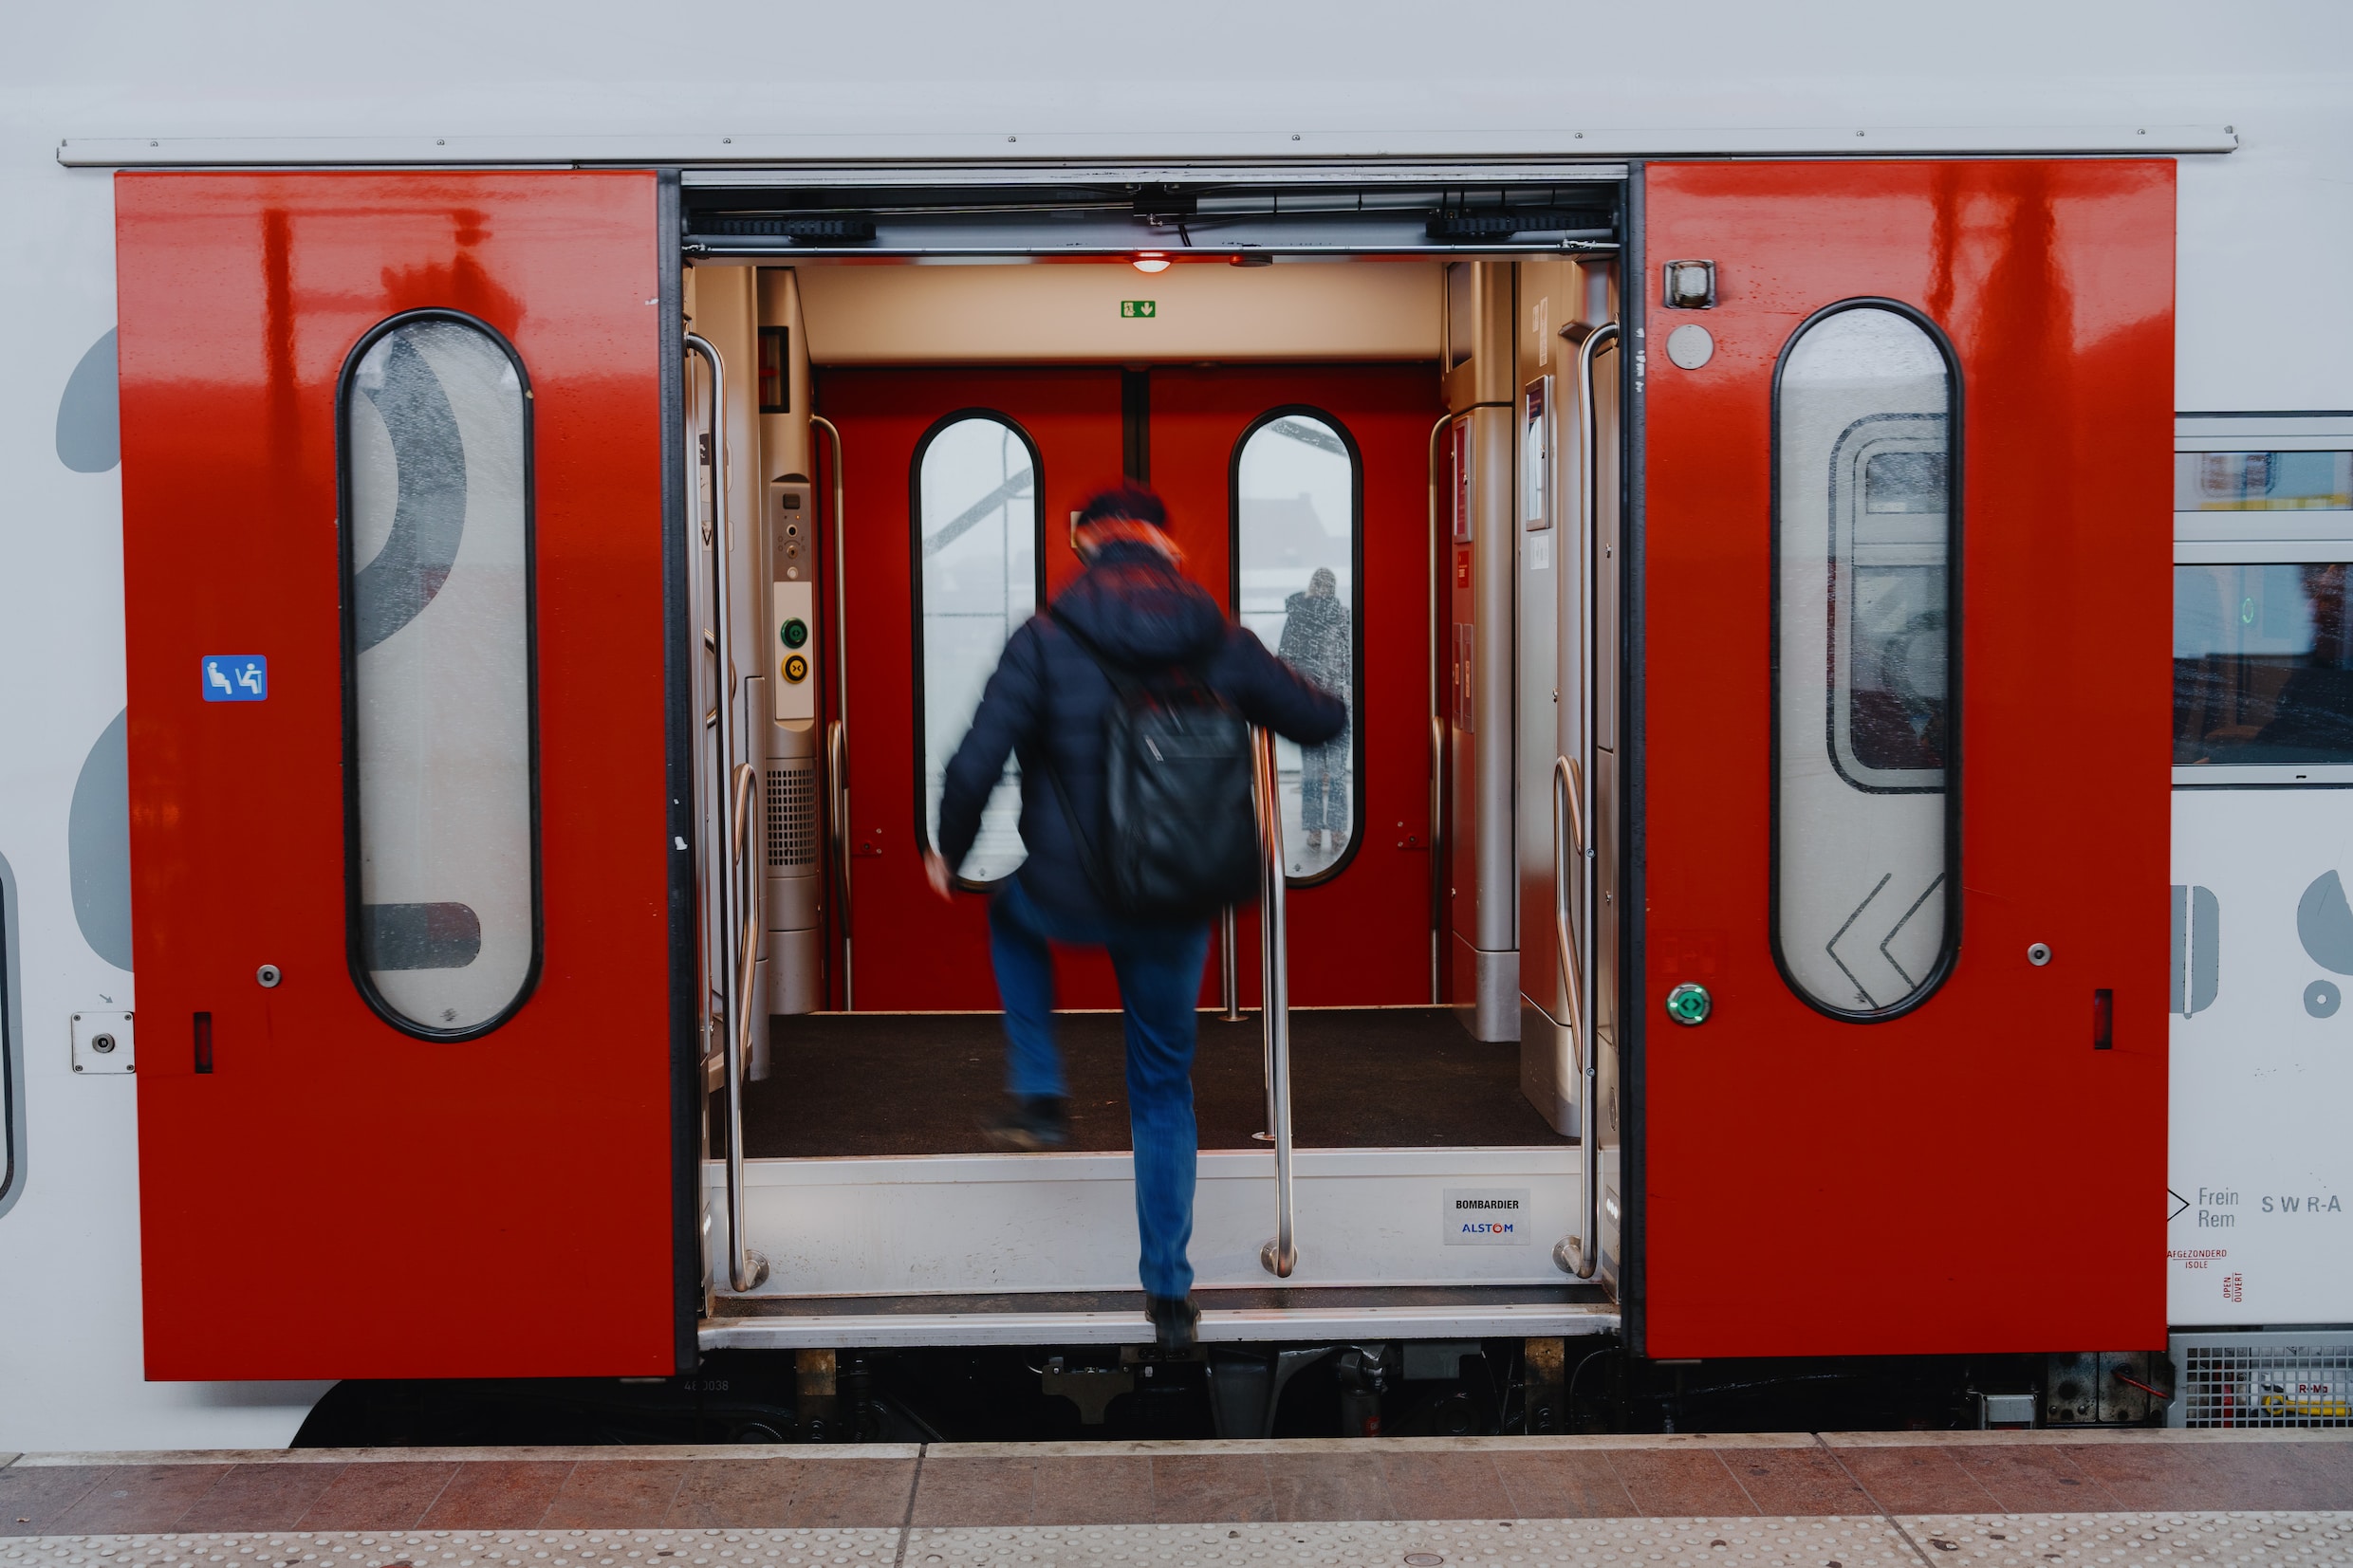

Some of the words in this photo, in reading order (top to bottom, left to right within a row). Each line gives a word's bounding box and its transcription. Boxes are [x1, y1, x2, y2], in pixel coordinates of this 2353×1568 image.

[1455, 1200, 1519, 1209] BOMBARDIER
[2198, 1187, 2239, 1206] Frein
[2198, 1209, 2235, 1227] Rem
[1461, 1223, 1513, 1233] ALSTOM
[2223, 1276, 2232, 1299] OPEN
[2233, 1271, 2243, 1303] OUVERT
